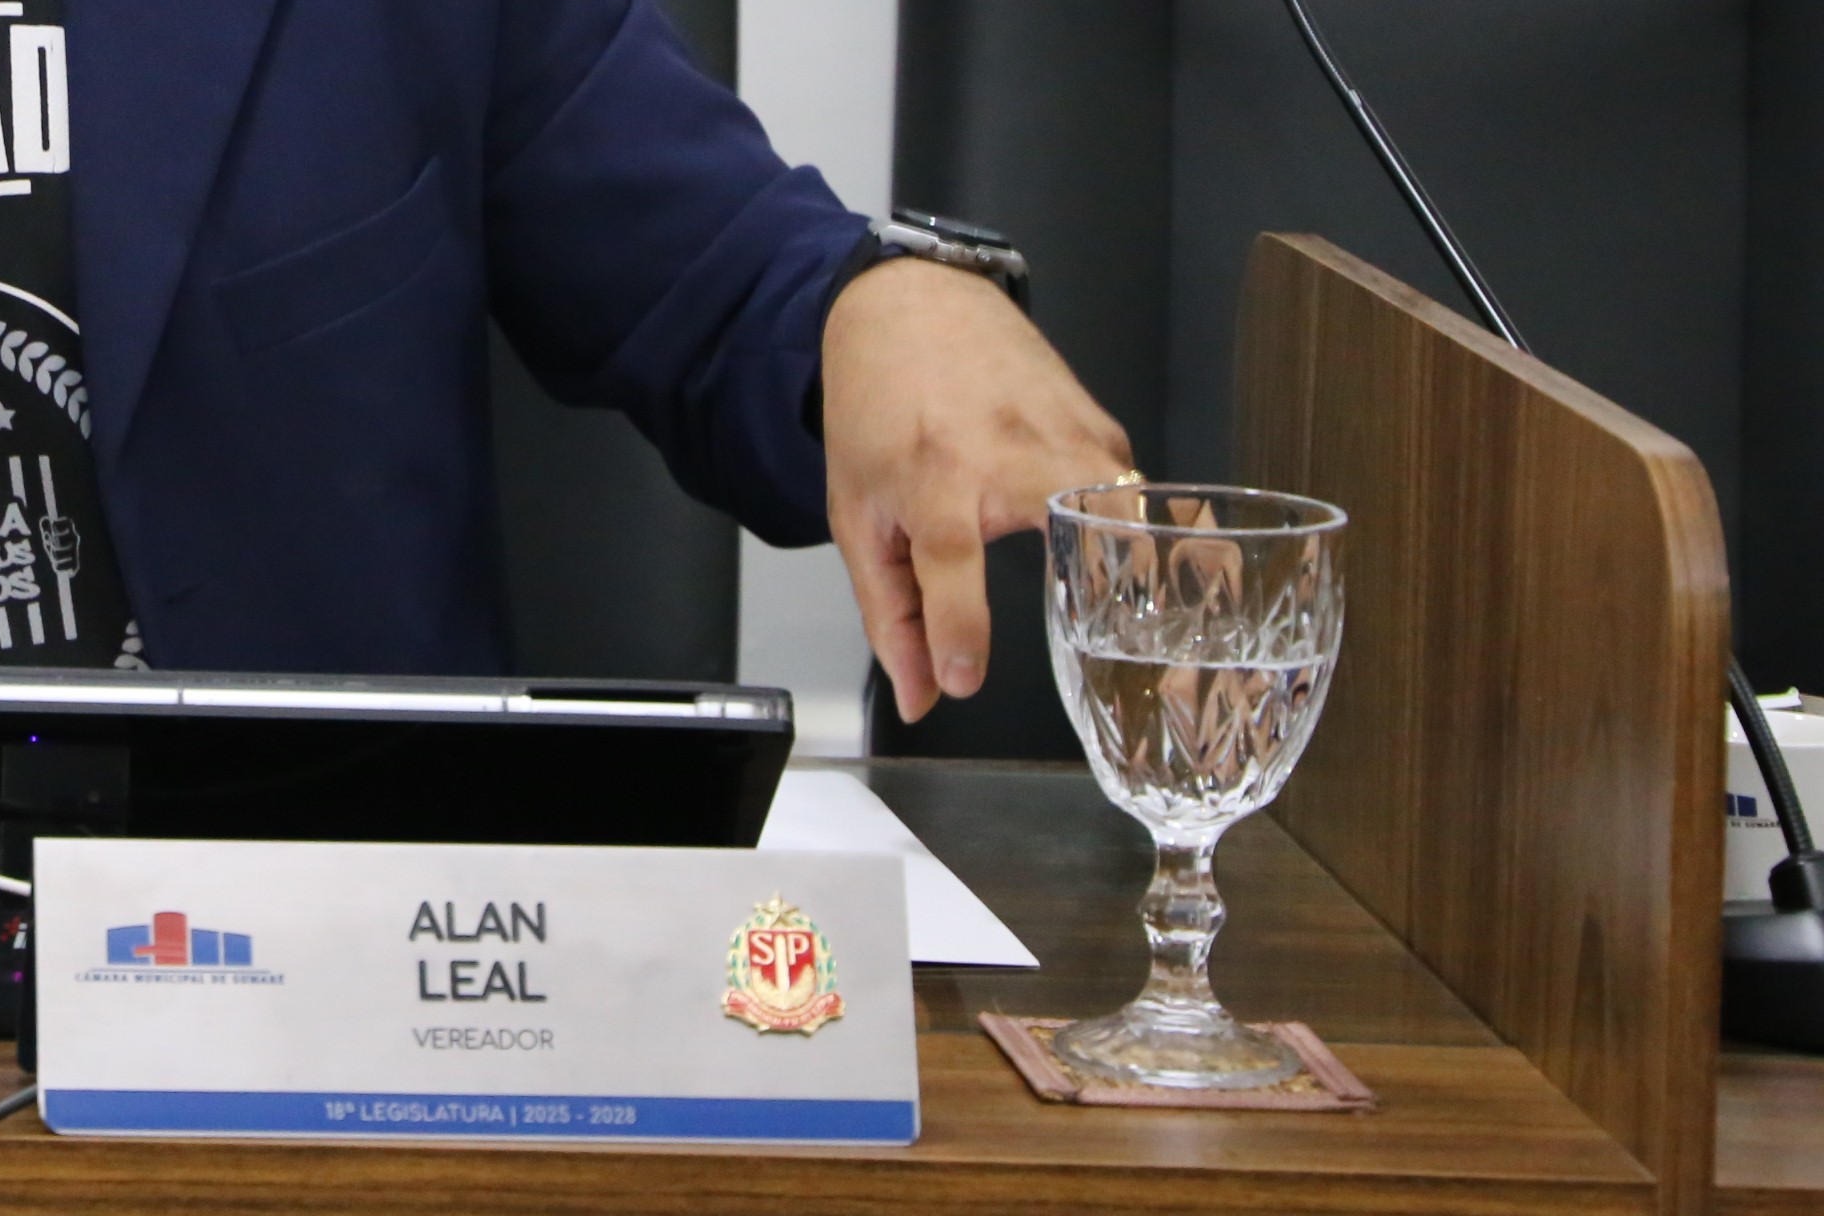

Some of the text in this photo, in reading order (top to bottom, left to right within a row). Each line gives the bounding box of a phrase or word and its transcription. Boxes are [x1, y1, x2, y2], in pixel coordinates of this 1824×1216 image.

[409, 901, 546, 942] ALAN
[750, 933, 810, 966] SP
[418, 960, 547, 1001] LEAL
[412, 1028, 554, 1050] VEREADOR
[360, 1102, 504, 1123] LEGISLATURA
[523, 1105, 570, 1123] 2025
[589, 1105, 637, 1125] 2028
